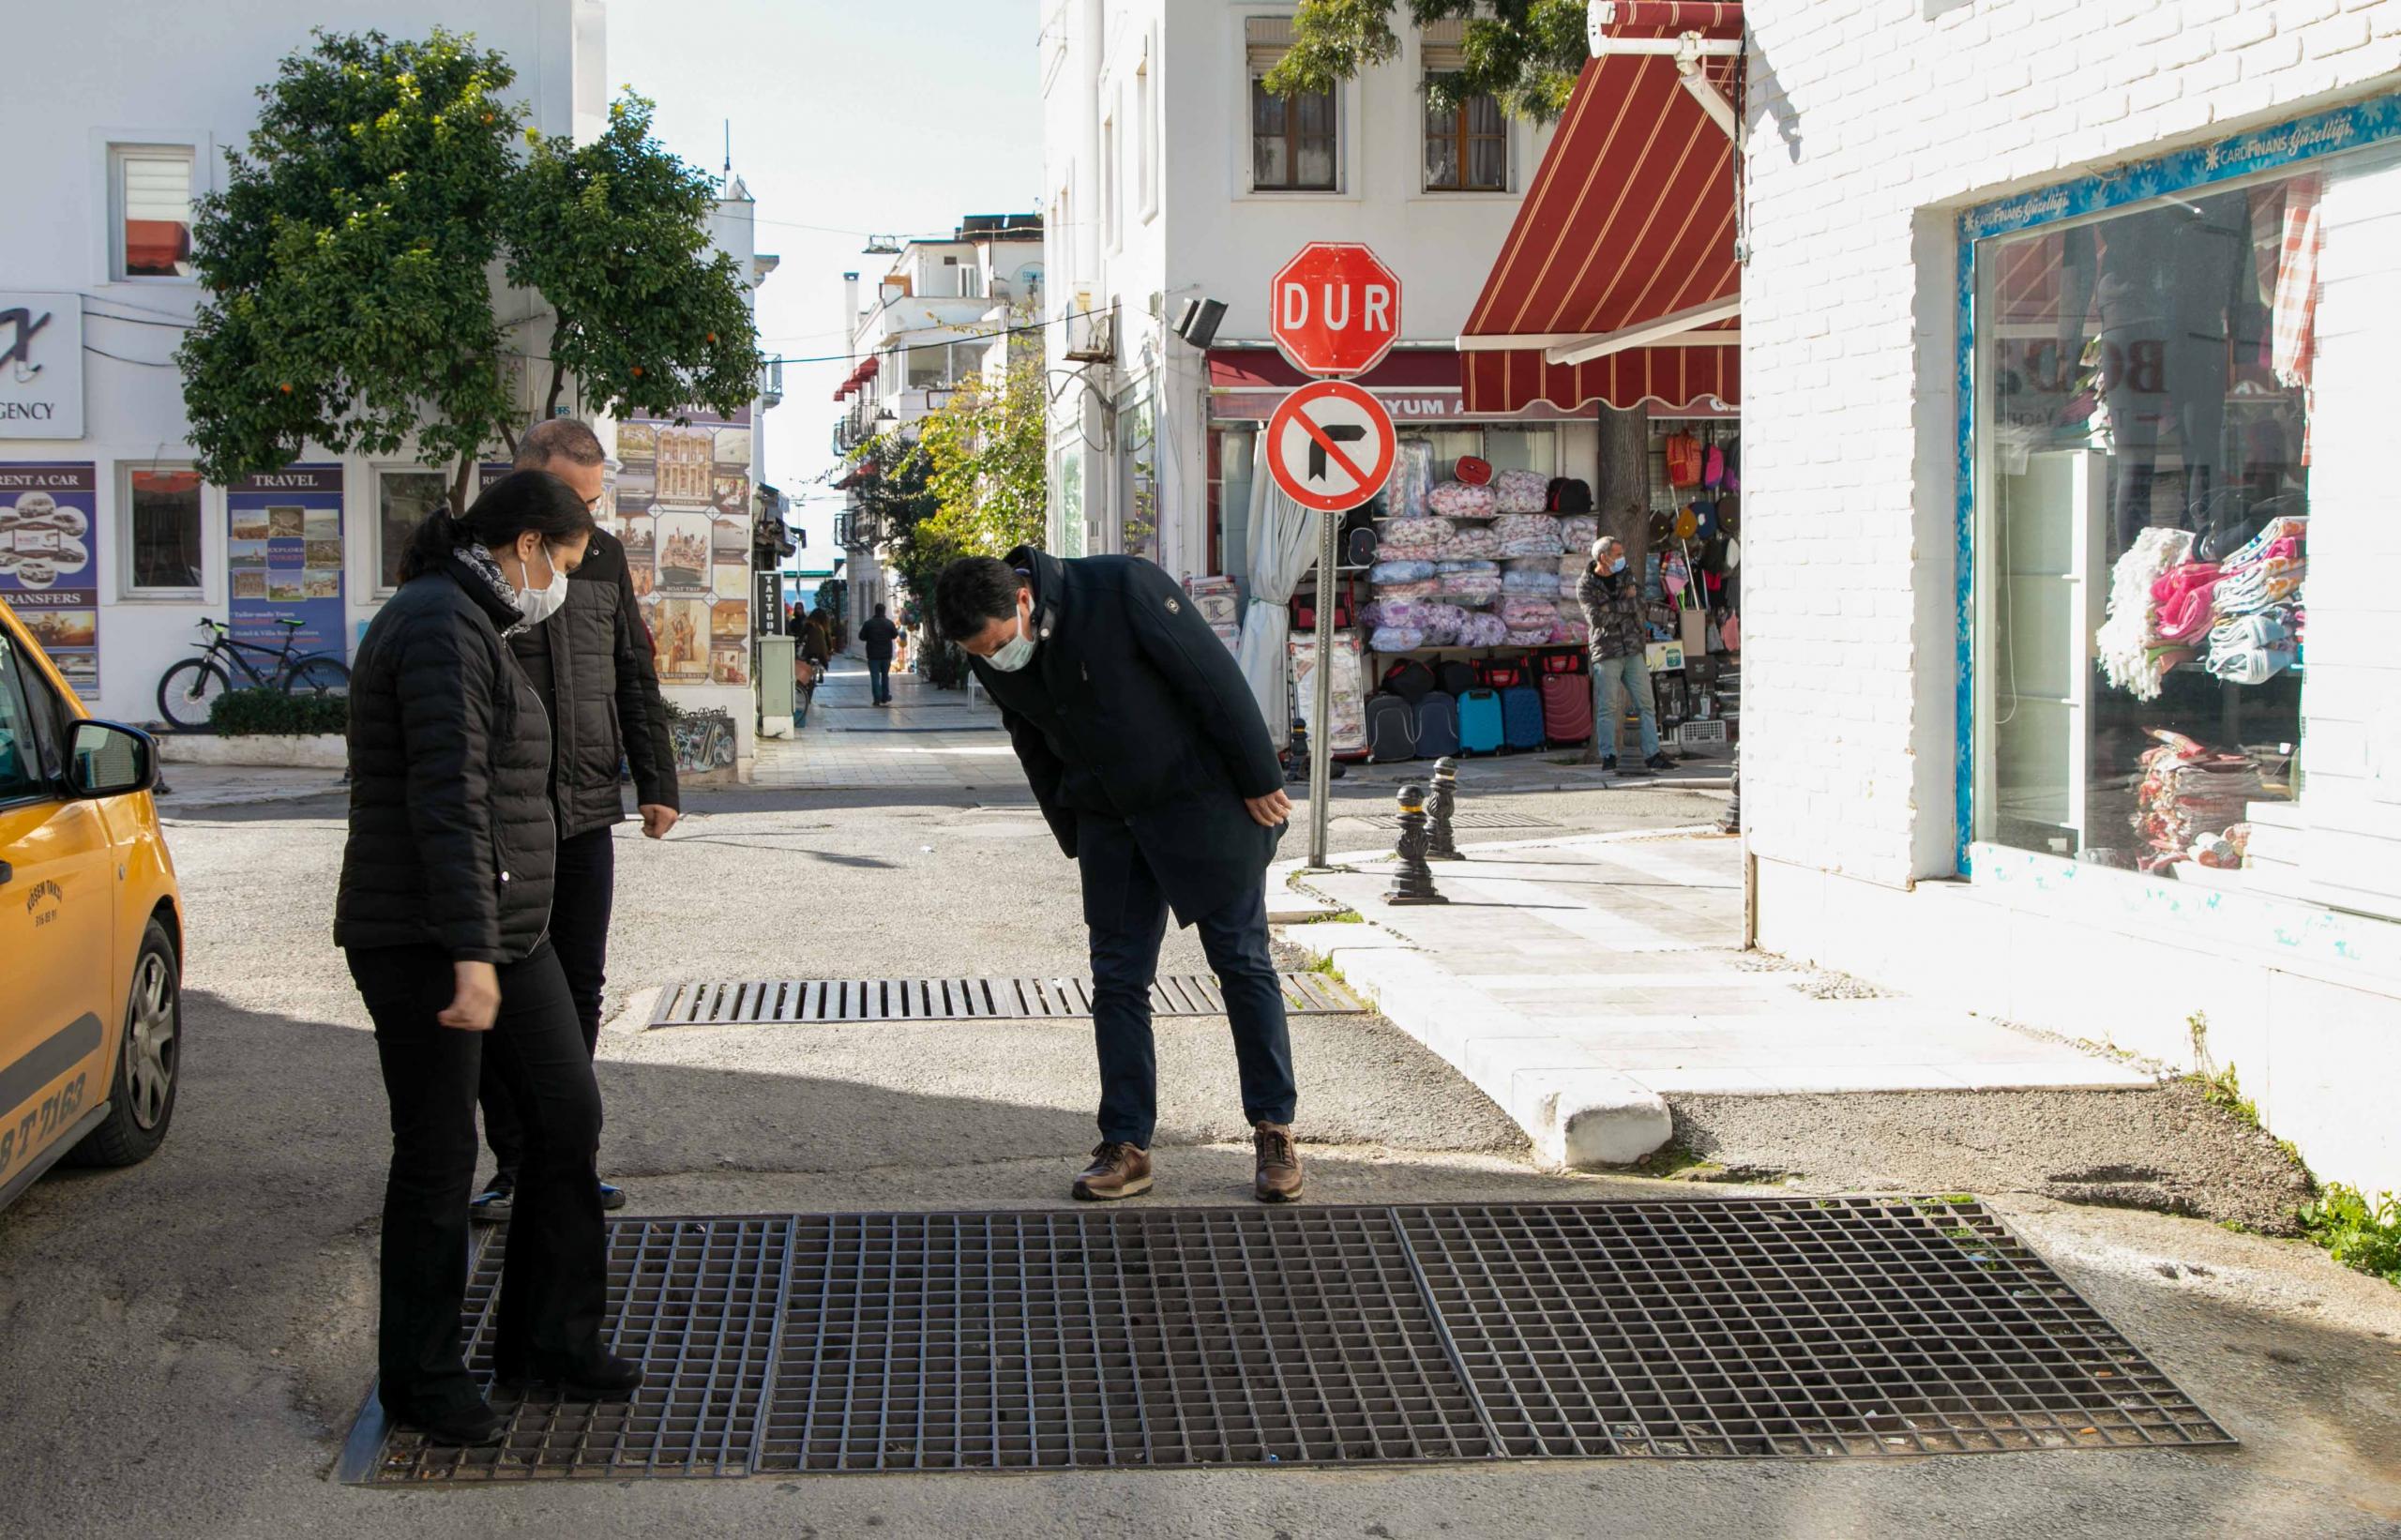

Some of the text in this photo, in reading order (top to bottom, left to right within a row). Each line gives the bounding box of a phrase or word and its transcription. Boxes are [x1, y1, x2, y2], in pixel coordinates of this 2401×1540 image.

[1284, 283, 1390, 331] DUR
[36, 476, 47, 486] A
[48, 475, 80, 486] CAR
[251, 475, 319, 487] TRAVEL
